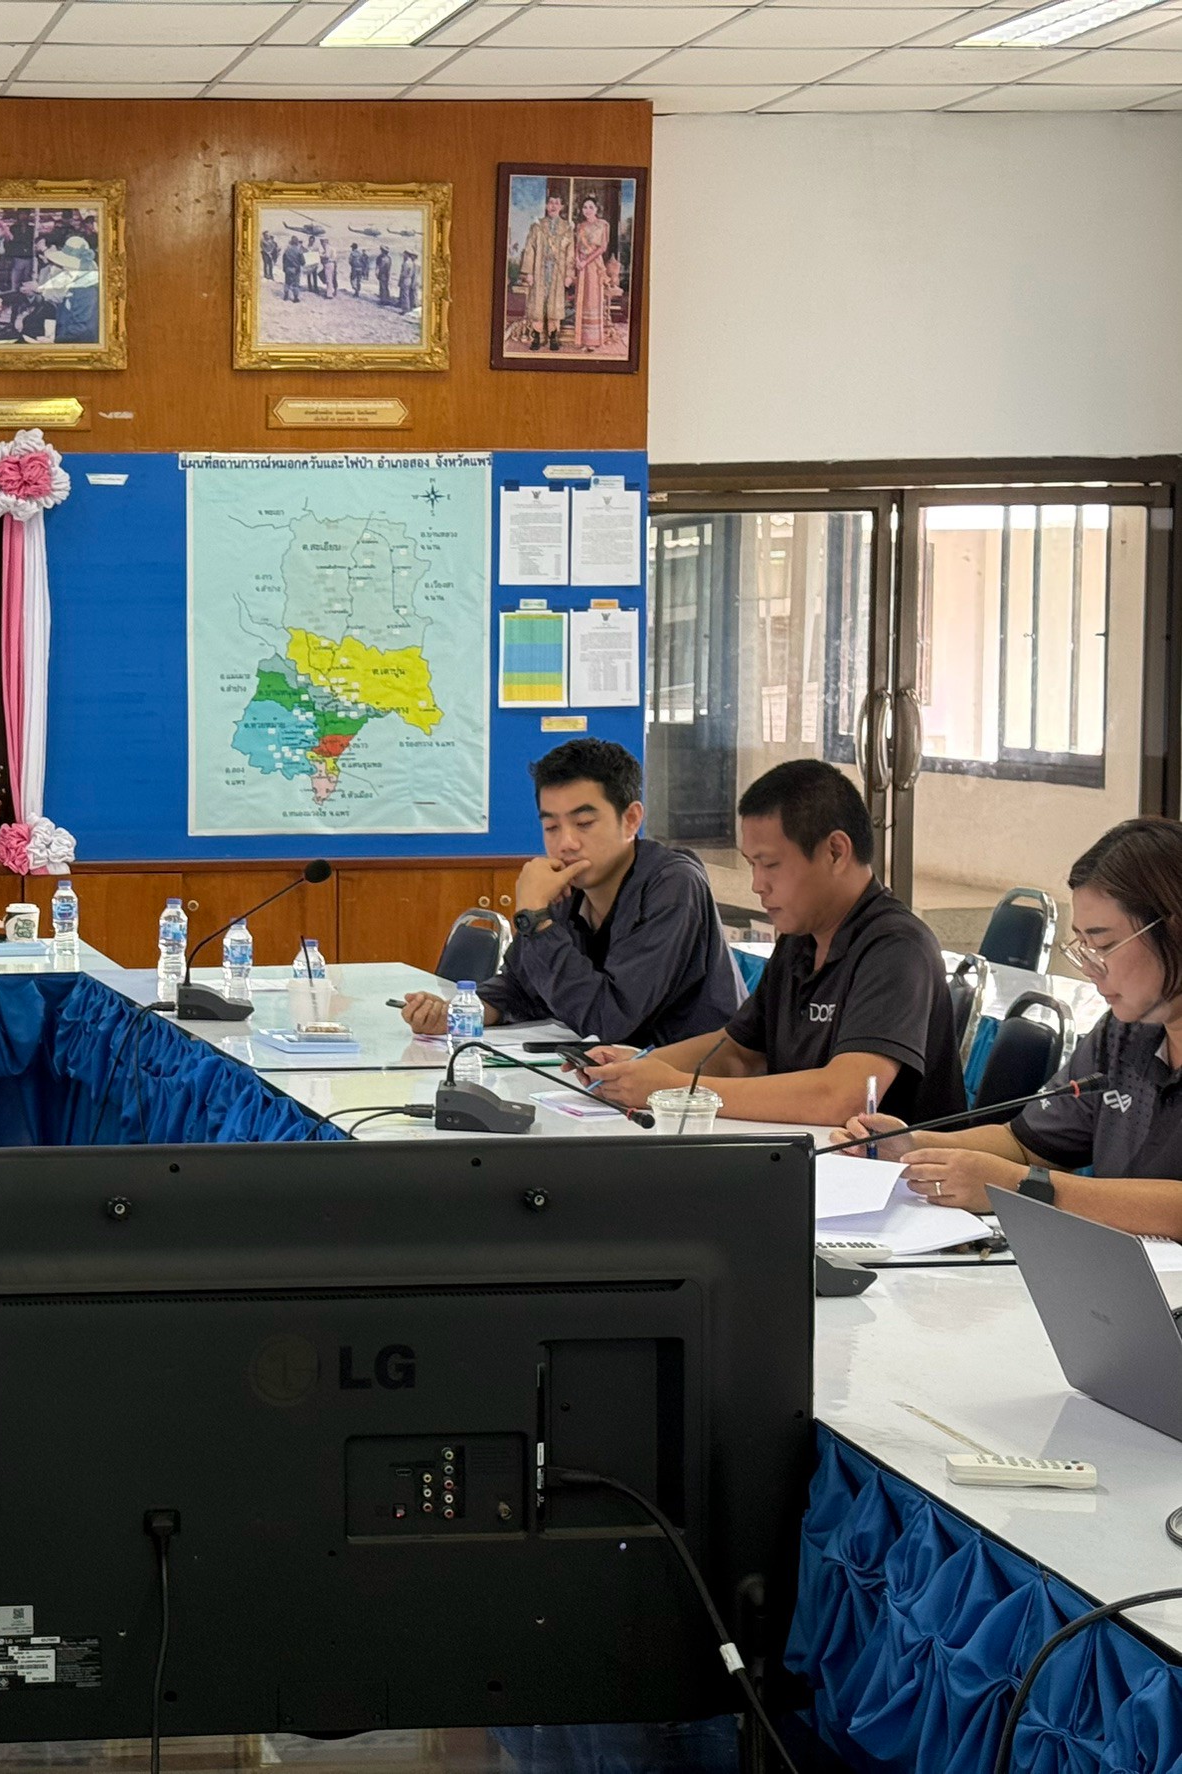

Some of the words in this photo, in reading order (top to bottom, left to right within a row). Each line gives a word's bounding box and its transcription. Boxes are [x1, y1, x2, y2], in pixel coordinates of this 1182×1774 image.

[377, 456, 430, 469] อำเภอสอง
[339, 1344, 416, 1390] LG
